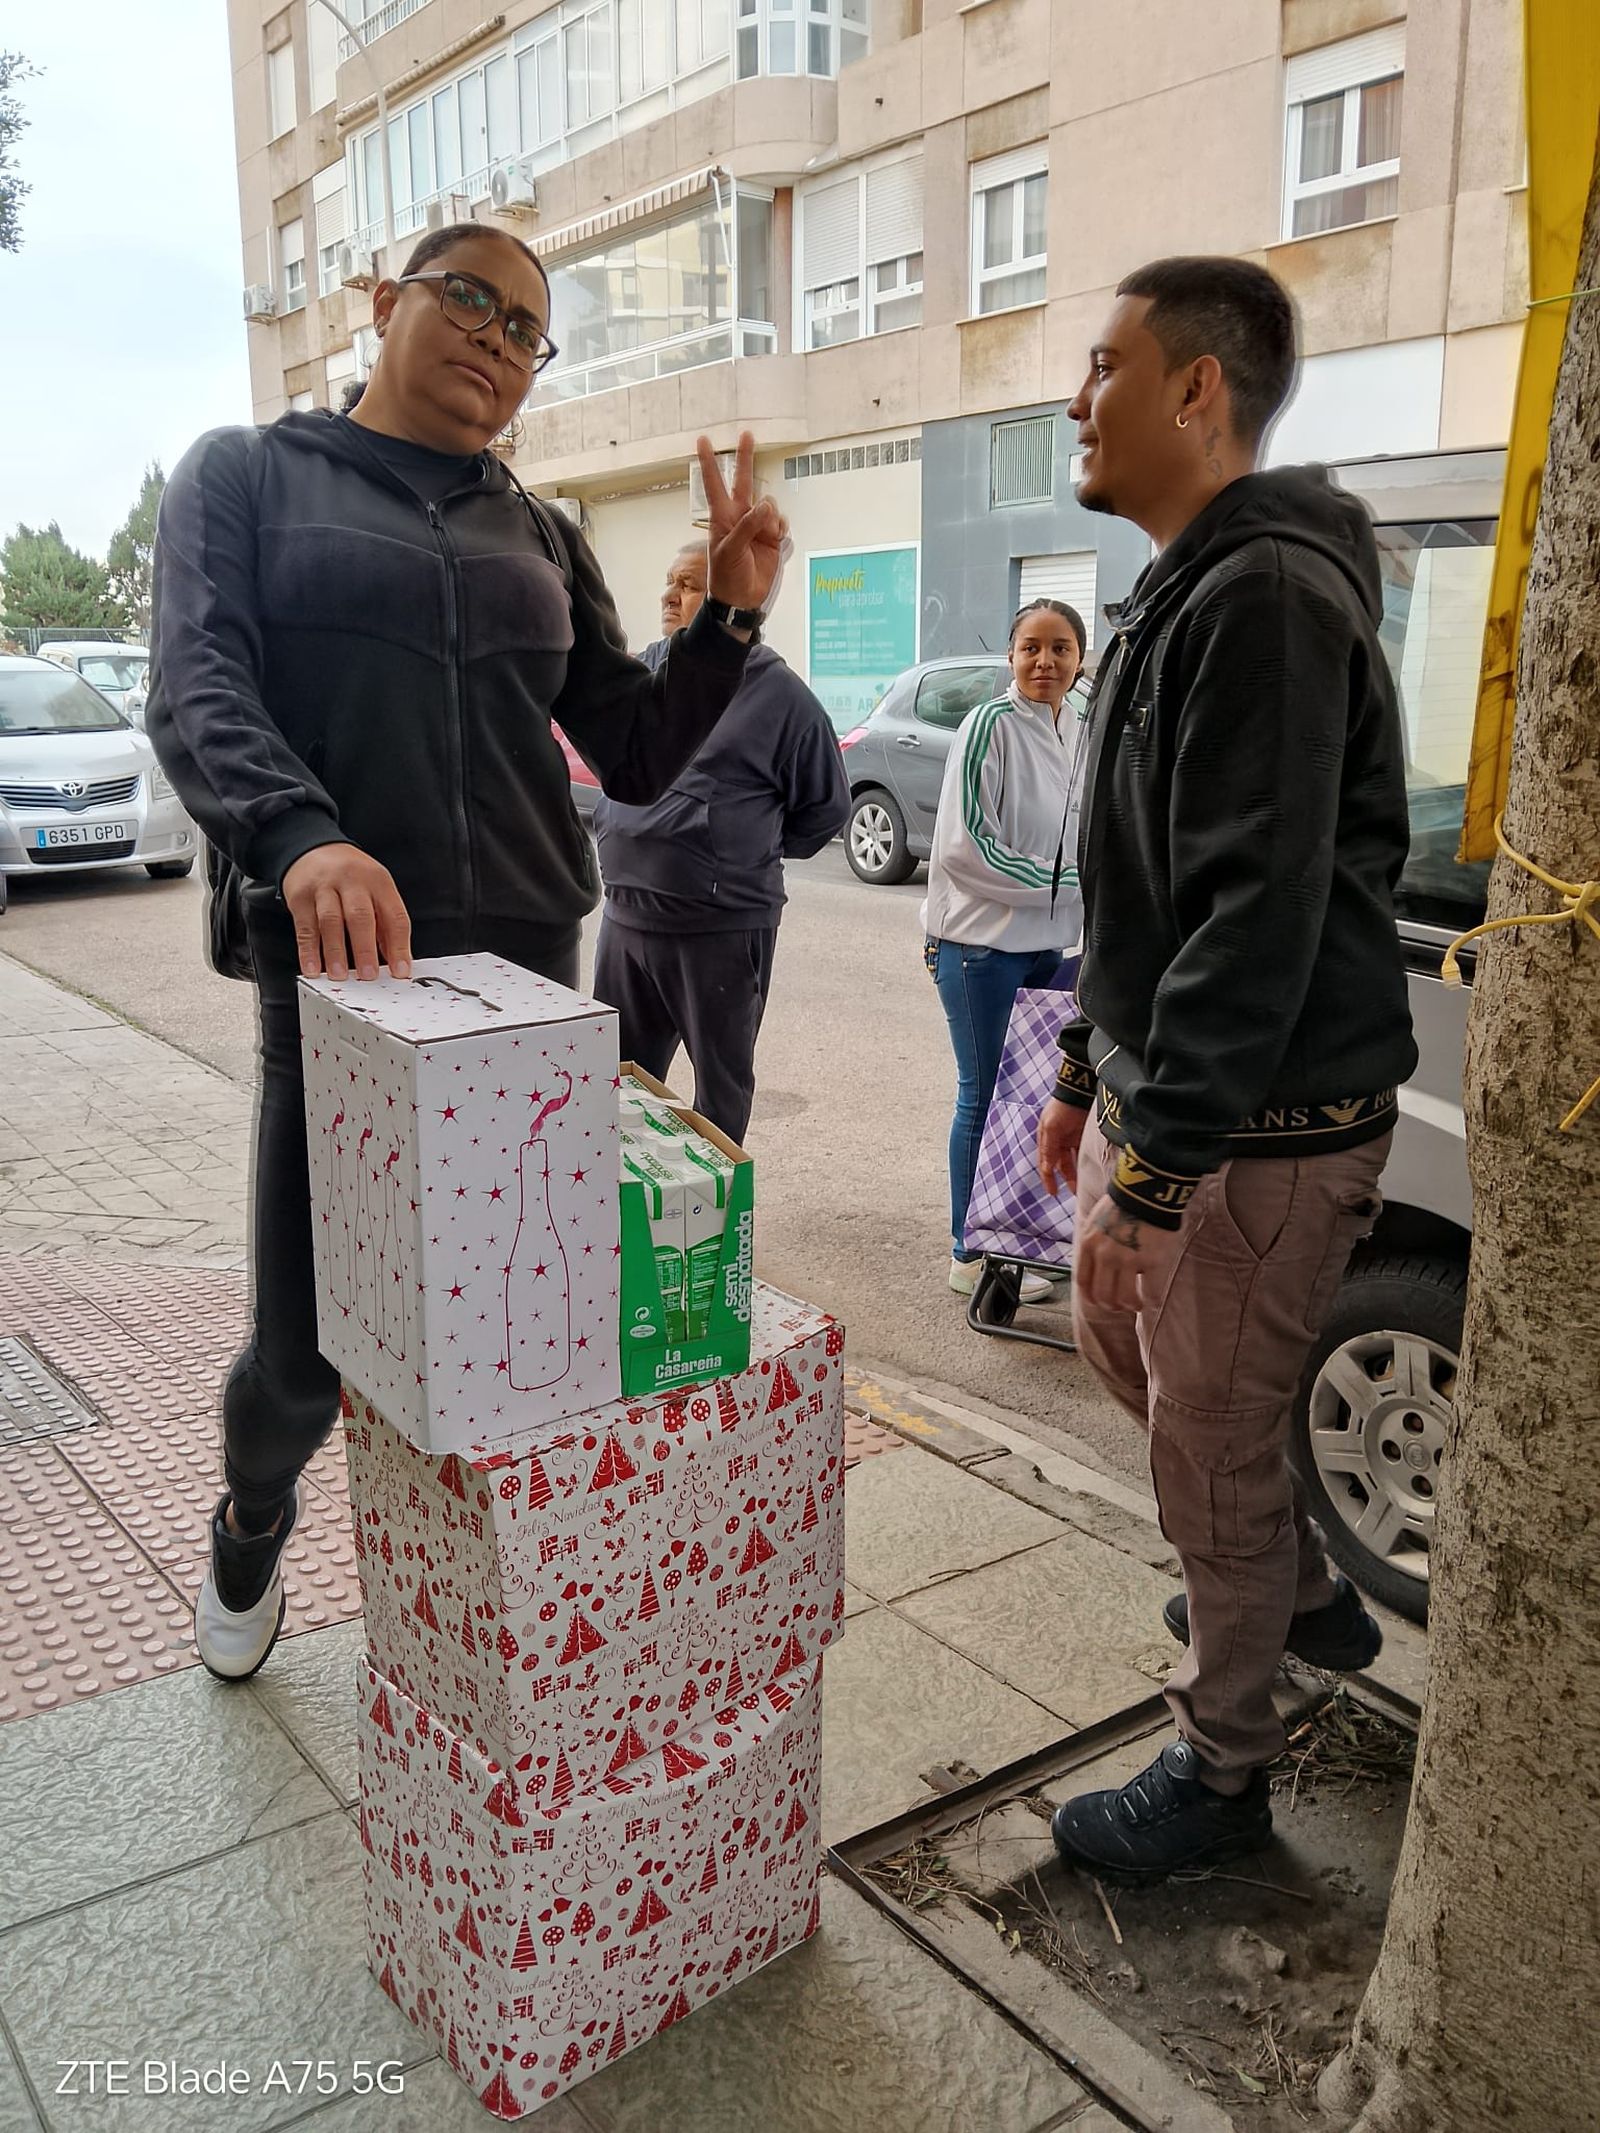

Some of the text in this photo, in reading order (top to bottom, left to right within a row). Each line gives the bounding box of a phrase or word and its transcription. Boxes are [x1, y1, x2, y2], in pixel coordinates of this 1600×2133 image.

[49, 825, 124, 844] 6351 GPD
[732, 1211, 751, 1323] desnatada
[722, 1263, 738, 1308] semi
[655, 1354, 722, 1380] Casareña
[665, 1349, 681, 1364] La
[515, 1493, 603, 1542] Feliz Navidad
[639, 1780, 686, 1809] Navidad
